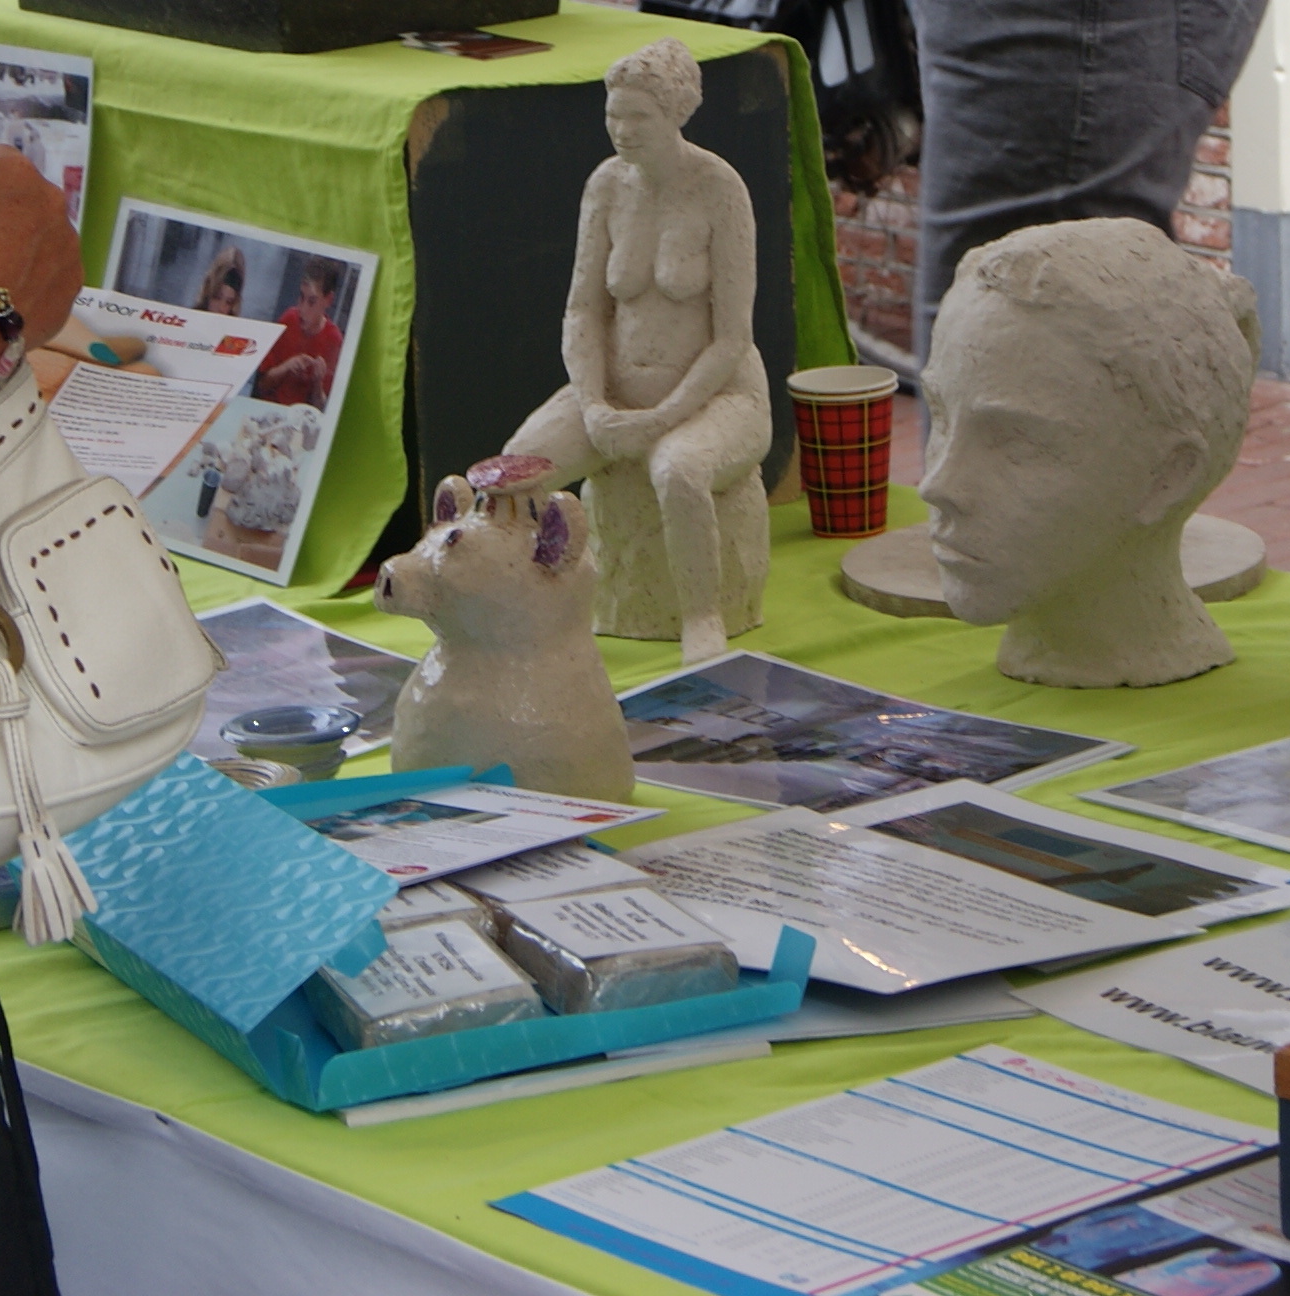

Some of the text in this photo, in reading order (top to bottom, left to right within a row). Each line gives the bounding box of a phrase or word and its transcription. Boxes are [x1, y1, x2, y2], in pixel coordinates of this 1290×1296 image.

[98, 300, 139, 318] voor
[139, 308, 188, 328] Kidz
[1099, 987, 1276, 1054] www.blauw
